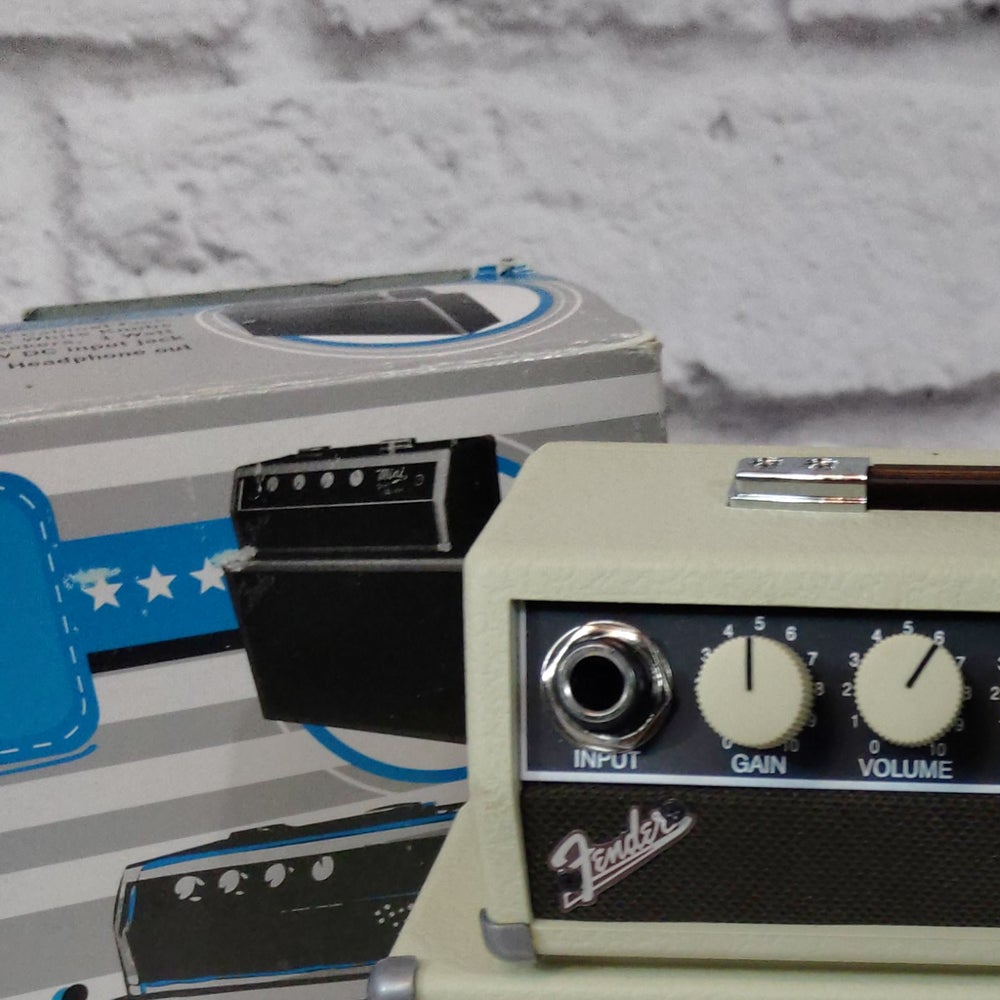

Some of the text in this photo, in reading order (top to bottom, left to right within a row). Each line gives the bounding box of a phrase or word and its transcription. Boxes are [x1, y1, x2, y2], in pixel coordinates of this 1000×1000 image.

[8, 344, 192, 369] Headphone out
[754, 616, 766, 631] 5
[902, 620, 914, 634] 5
[722, 624, 734, 638] 4
[785, 626, 797, 641] 6
[871, 629, 882, 641] 4
[934, 630, 945, 645] 6
[807, 652, 819, 666] 7
[849, 652, 861, 667] 3
[842, 682, 854, 696] 2
[990, 686, 1000, 700] 2
[851, 714, 859, 728] 1
[869, 740, 880, 754] 0
[930, 743, 947, 757] 10
[573, 749, 641, 770] INPUT
[731, 753, 787, 774] GAIN
[858, 758, 954, 779] VOLUME
[551, 809, 693, 909] Fender
